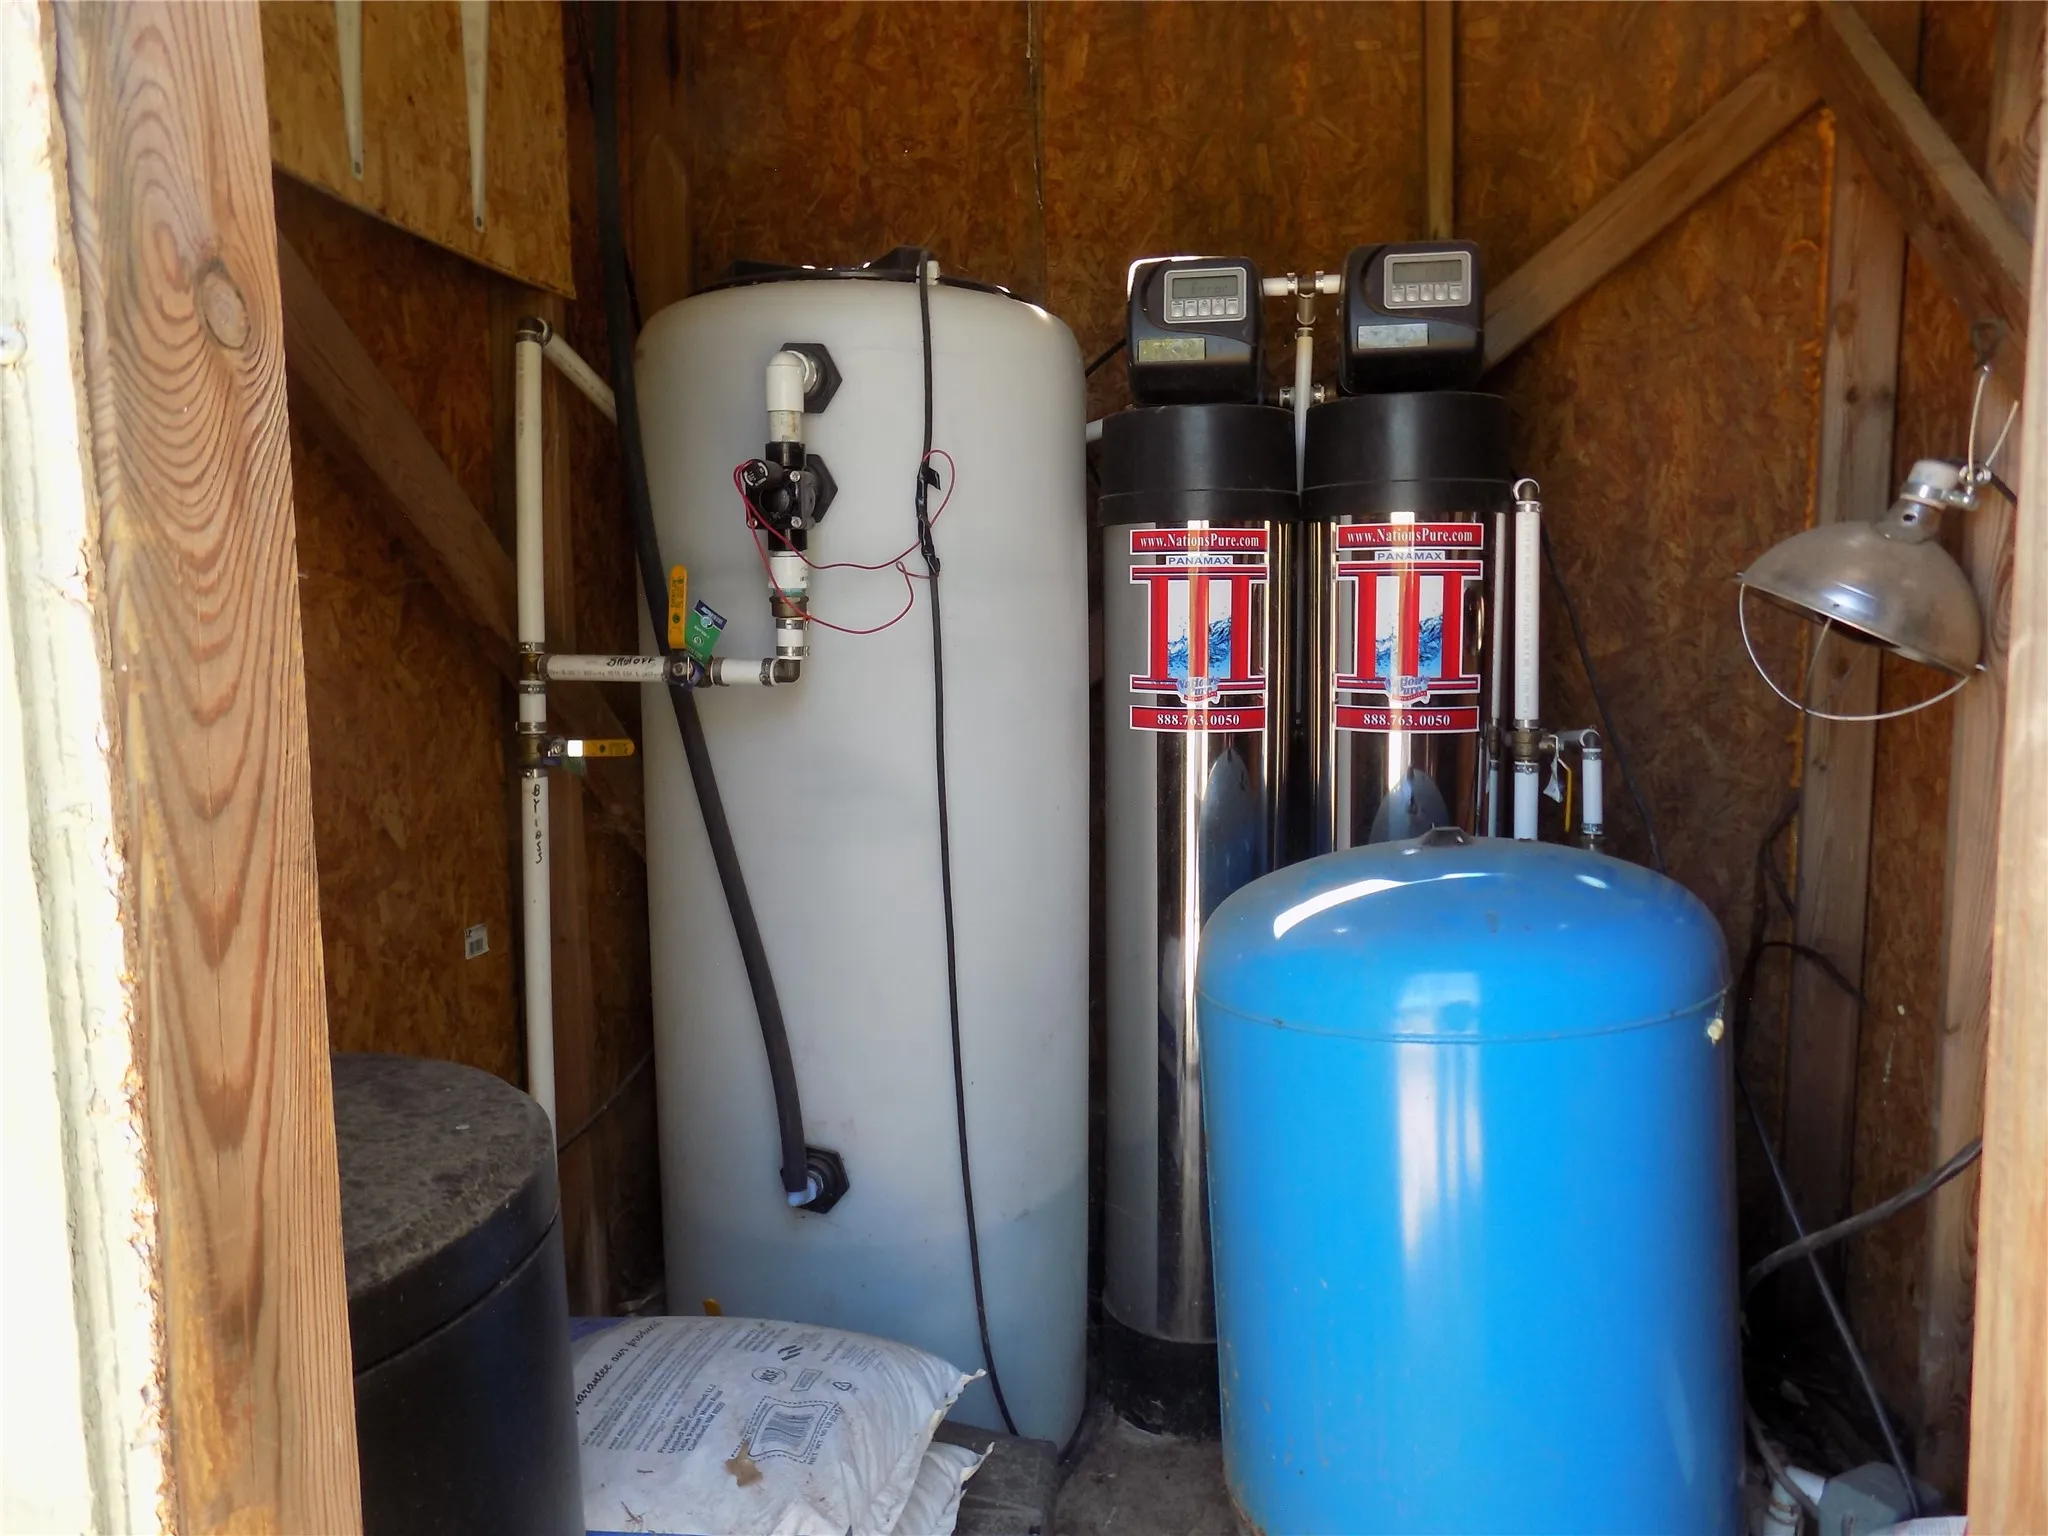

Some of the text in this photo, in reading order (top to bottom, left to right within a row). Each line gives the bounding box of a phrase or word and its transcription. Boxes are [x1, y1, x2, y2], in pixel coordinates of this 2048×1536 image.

[1140, 533, 1259, 548] www.NationsPure.com
[1347, 528, 1473, 543] www.NationsPure.com
[1168, 557, 1231, 565] PANAMAX
[1377, 552, 1442, 561] PANAMAX
[1157, 714, 1240, 726] 888.763.0050
[1363, 713, 1450, 727] 888.763.0050
[576, 1364, 613, 1415] uarantee
[611, 1347, 629, 1362] our
